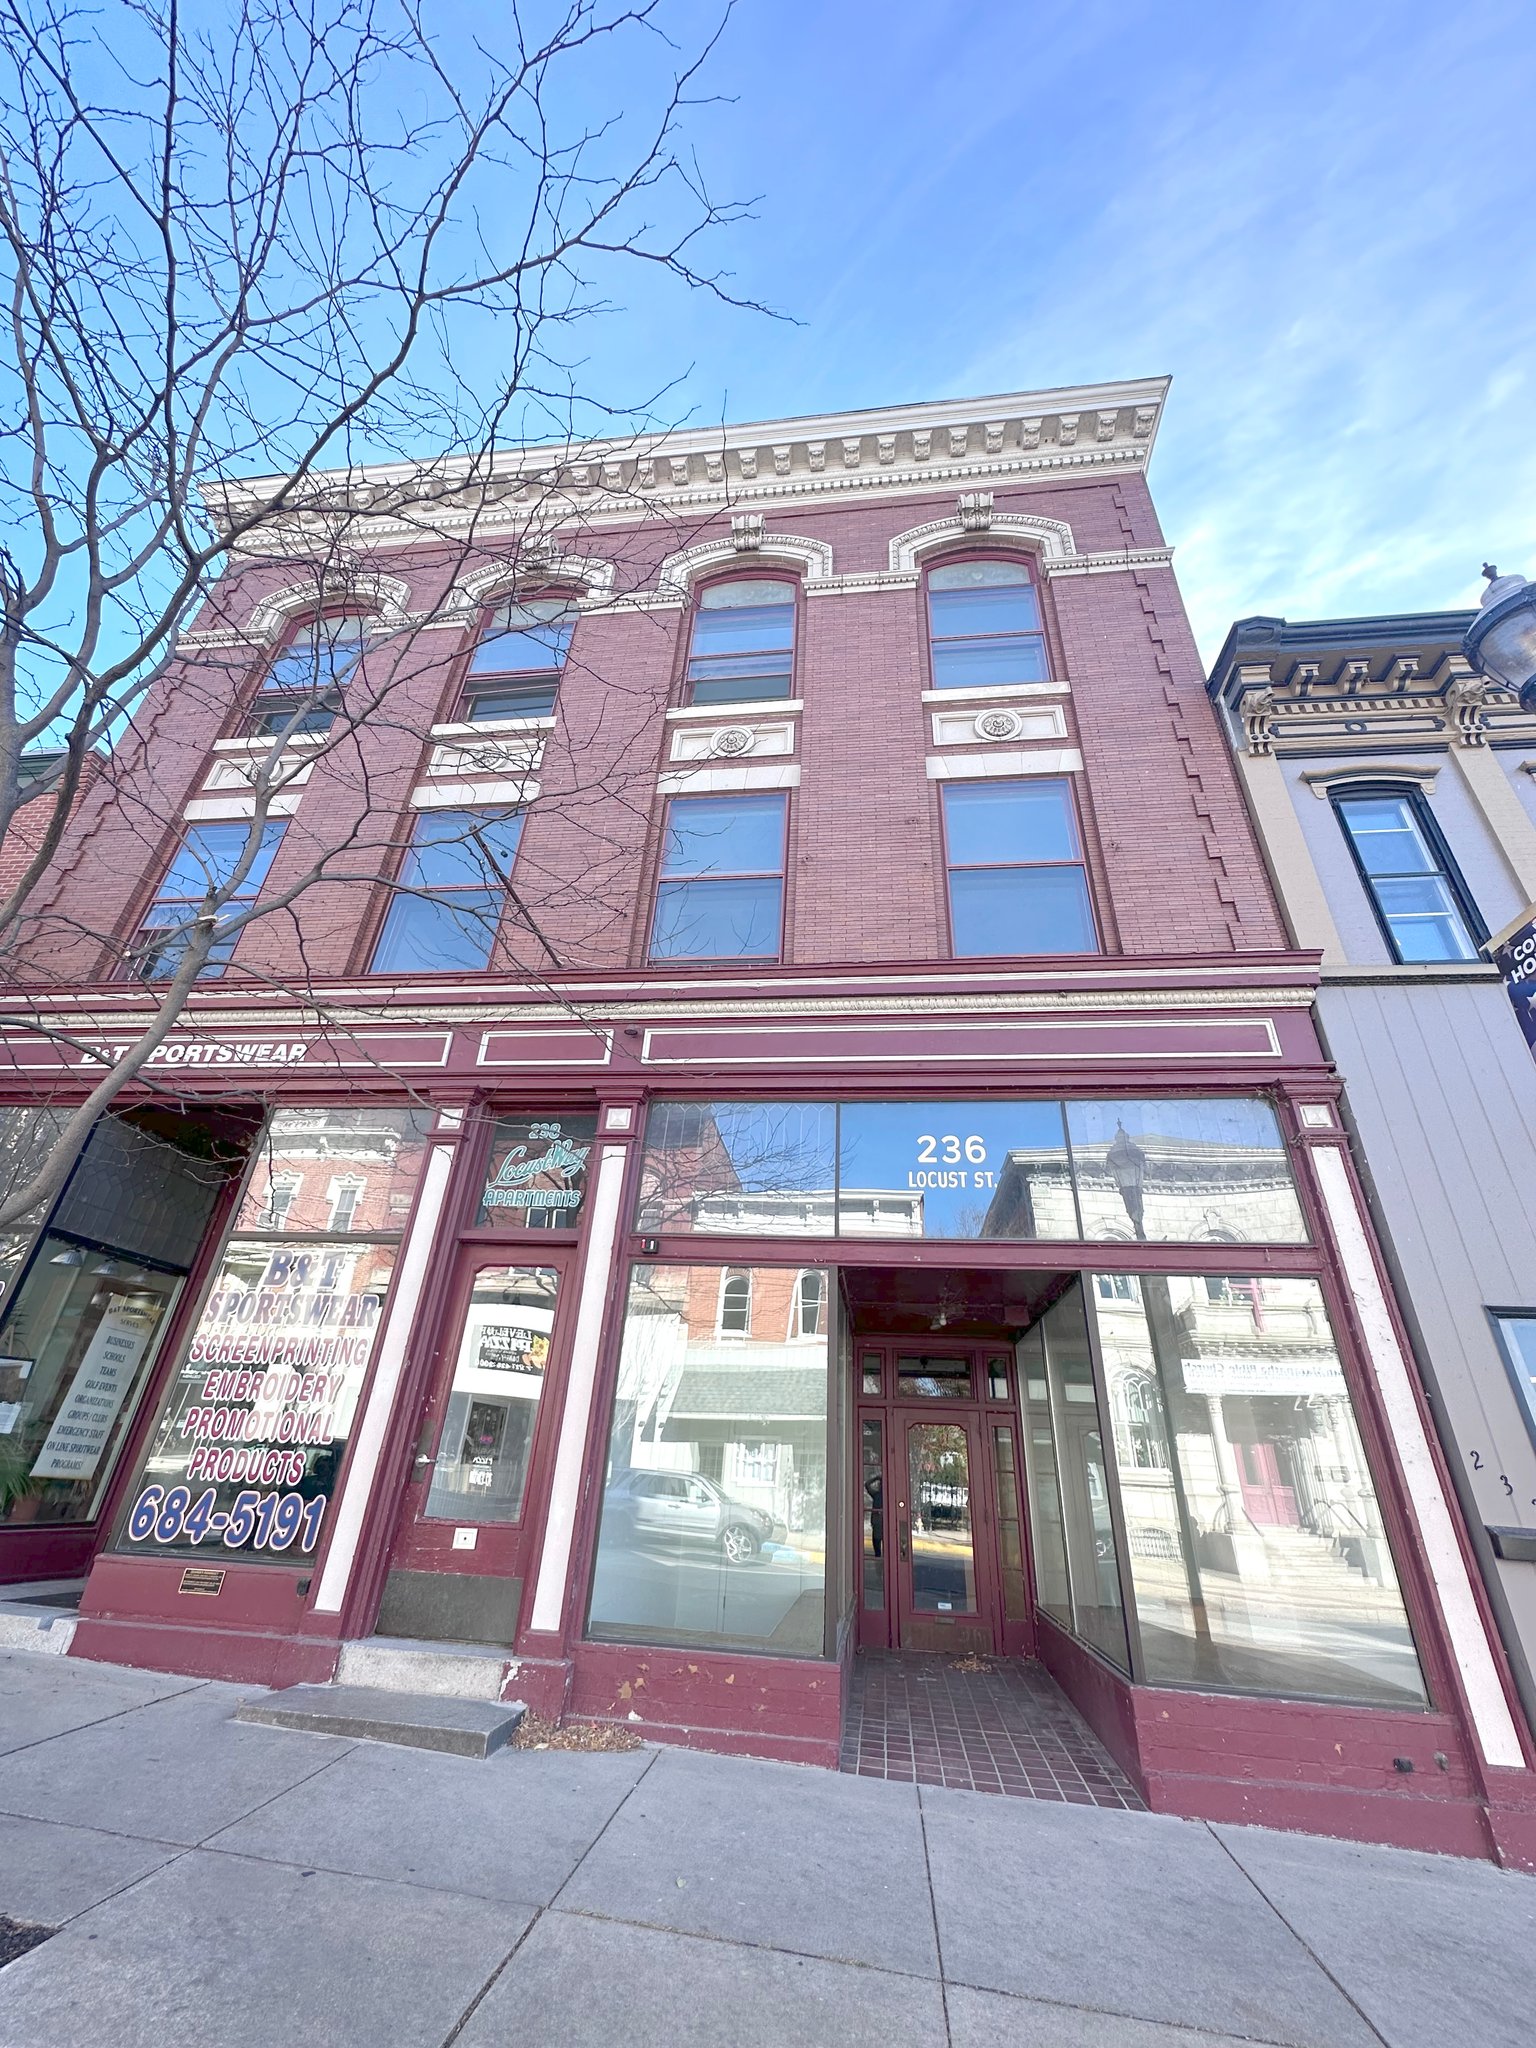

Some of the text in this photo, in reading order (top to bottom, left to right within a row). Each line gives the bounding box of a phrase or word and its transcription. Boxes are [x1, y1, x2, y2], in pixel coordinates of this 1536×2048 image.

[1513, 933, 1536, 961] CO
[1511, 956, 1536, 984] HO
[146, 1043, 308, 1063] PORTSWEAR
[486, 1139, 591, 1188] Locust Way
[916, 1135, 987, 1164] 236
[908, 1171, 998, 1188] LOCUST ST.
[483, 1189, 581, 1207] APARTMENTS
[262, 1250, 346, 1288] B&T
[205, 1291, 380, 1327] SPORTSWEAR
[189, 1333, 368, 1367] SCREENPRINTING
[100, 1365, 117, 1376] TEAMS
[202, 1370, 343, 1403] EMBROIDERY
[182, 1406, 333, 1445] PROMOTIONAL
[187, 1447, 306, 1485] PRODUCTS
[129, 1485, 326, 1552] 684-5191
